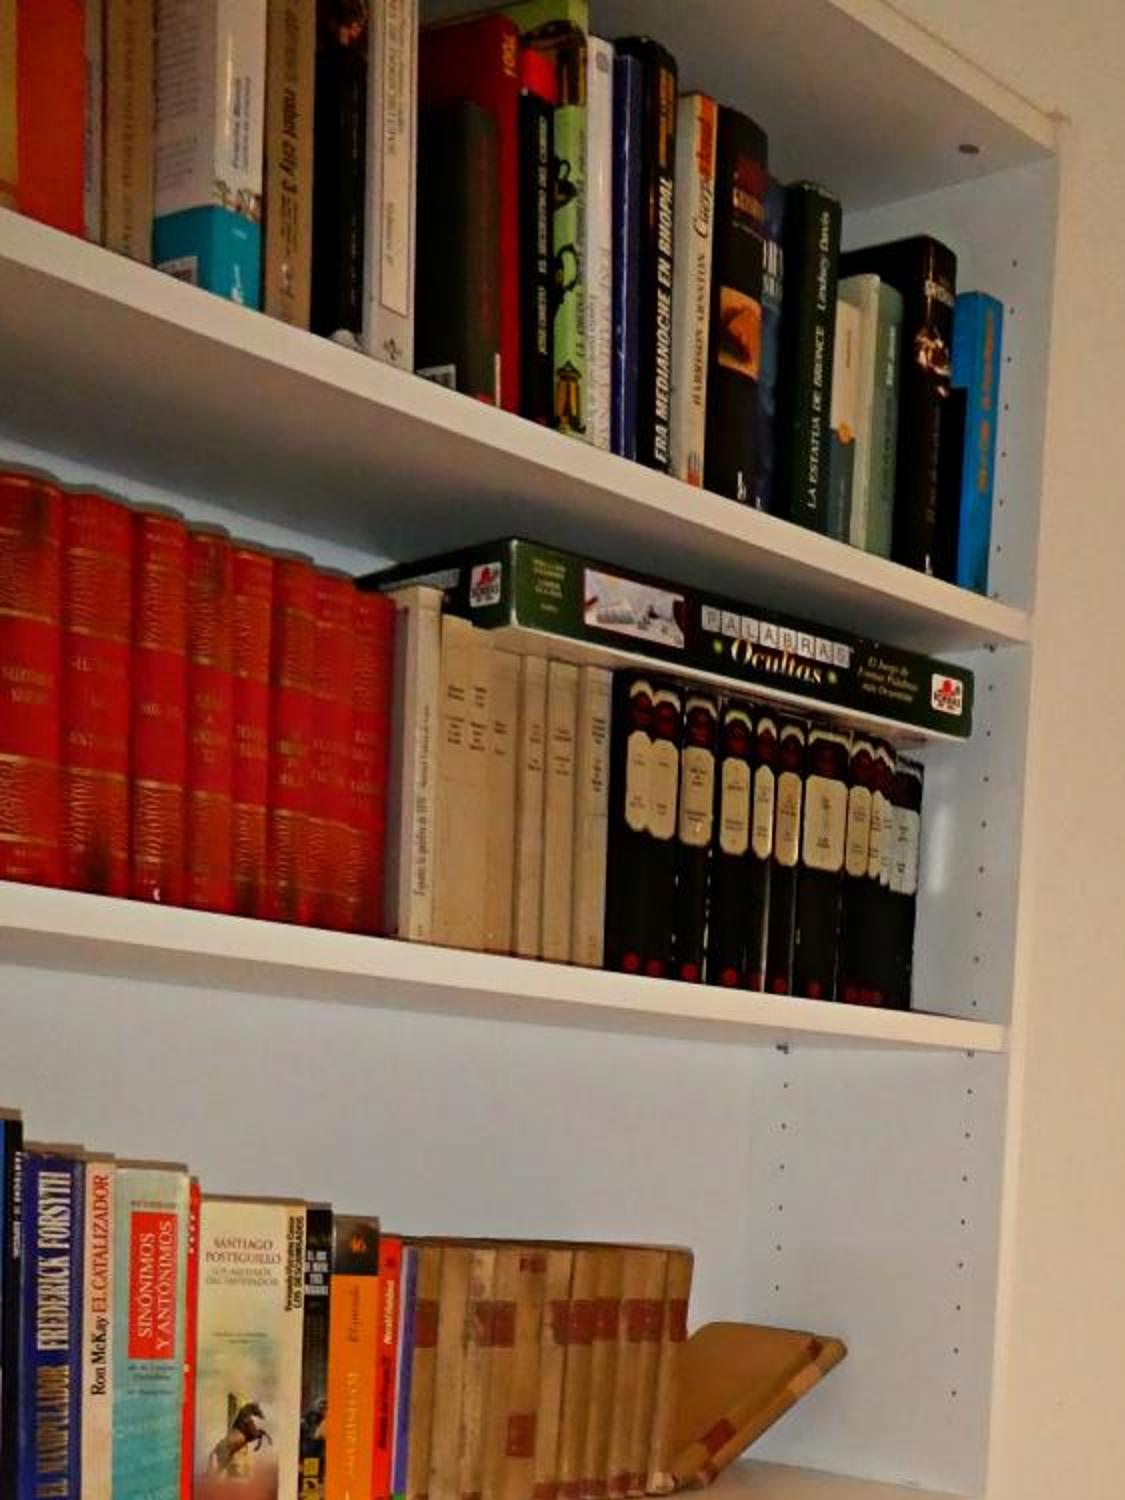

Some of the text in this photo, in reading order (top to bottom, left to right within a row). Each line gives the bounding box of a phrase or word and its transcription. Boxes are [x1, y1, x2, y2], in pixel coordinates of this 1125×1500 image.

[659, 261, 672, 283] EN
[656, 294, 672, 417] MEDIANOCHE
[808, 416, 822, 485] ESTATUA
[704, 608, 849, 666] PALABRAS
[731, 638, 821, 684] Ocultas
[37, 1171, 70, 1351] FREDERICK FORSYTH
[205, 1251, 281, 1265] POSTEGUILLO
[214, 1237, 273, 1251] SANTIAGO
[91, 1175, 110, 1396] Ron McKay EL CATALIZADOR
[134, 1232, 155, 1338] SINÓNIMOS
[154, 1220, 174, 1350] Y ANTÓNIMOS
